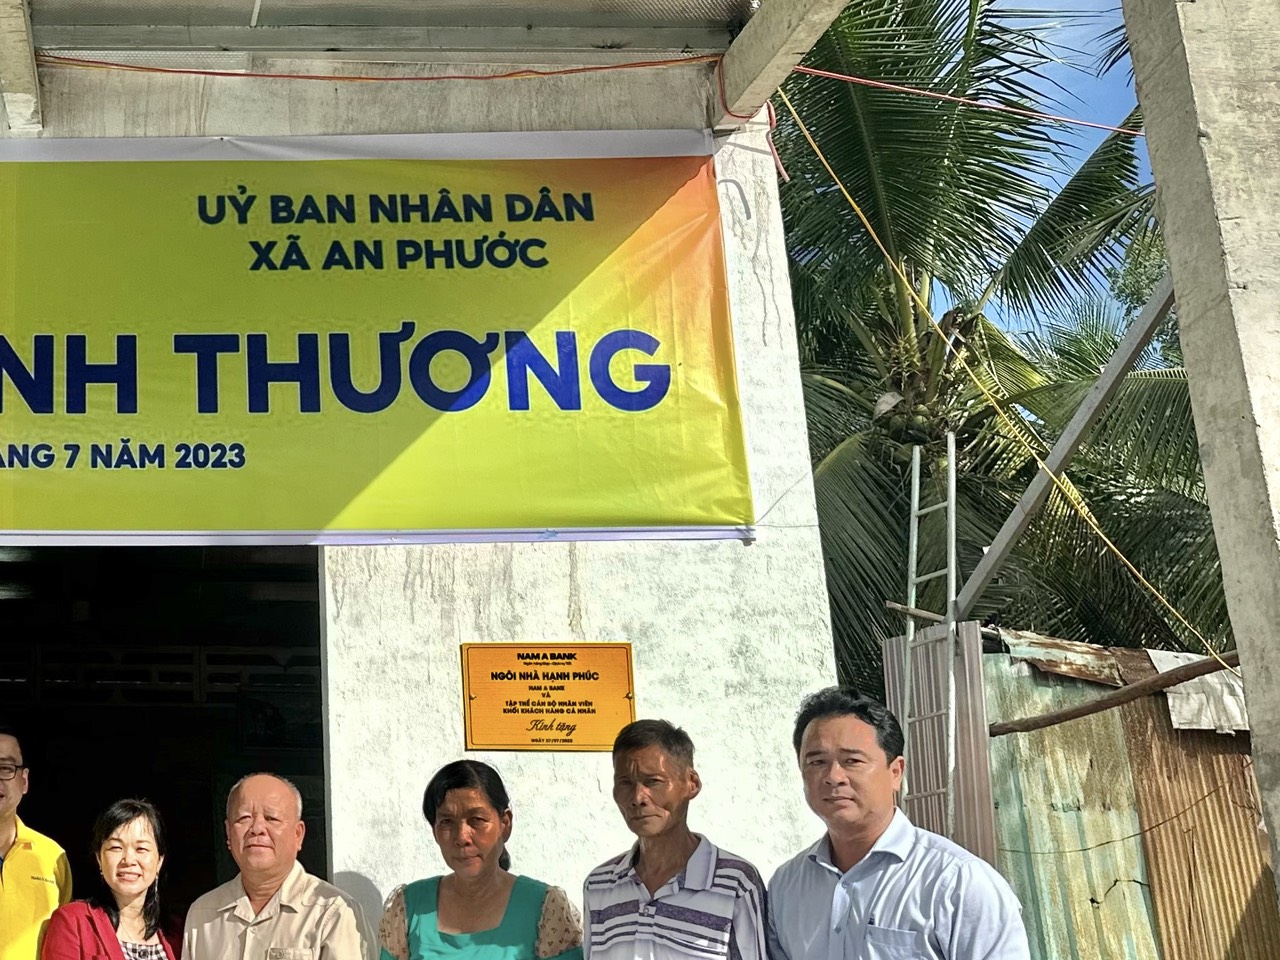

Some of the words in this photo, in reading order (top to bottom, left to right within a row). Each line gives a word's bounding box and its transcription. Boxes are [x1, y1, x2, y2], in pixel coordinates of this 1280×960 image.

[197, 184, 257, 225] UỶ
[269, 194, 356, 224] BAN
[369, 187, 494, 223] NHÂN
[504, 185, 595, 222] DÂN
[249, 234, 311, 271] XÃ
[321, 239, 384, 271] AN
[396, 231, 549, 270] PHƯỚC
[173, 320, 672, 414] THƯƠNG
[63, 443, 81, 469] 7
[90, 437, 165, 469] NĂM
[174, 442, 246, 469] 2023
[516, 652, 541, 660] NAM
[541, 652, 549, 660] A
[549, 652, 577, 660] BANK
[490, 670, 517, 681] NGÔI
[518, 669, 540, 681] NHÀ
[542, 671, 570, 683] HẠNH
[572, 669, 600, 681] PHÚC
[526, 718, 556, 732] Kính
